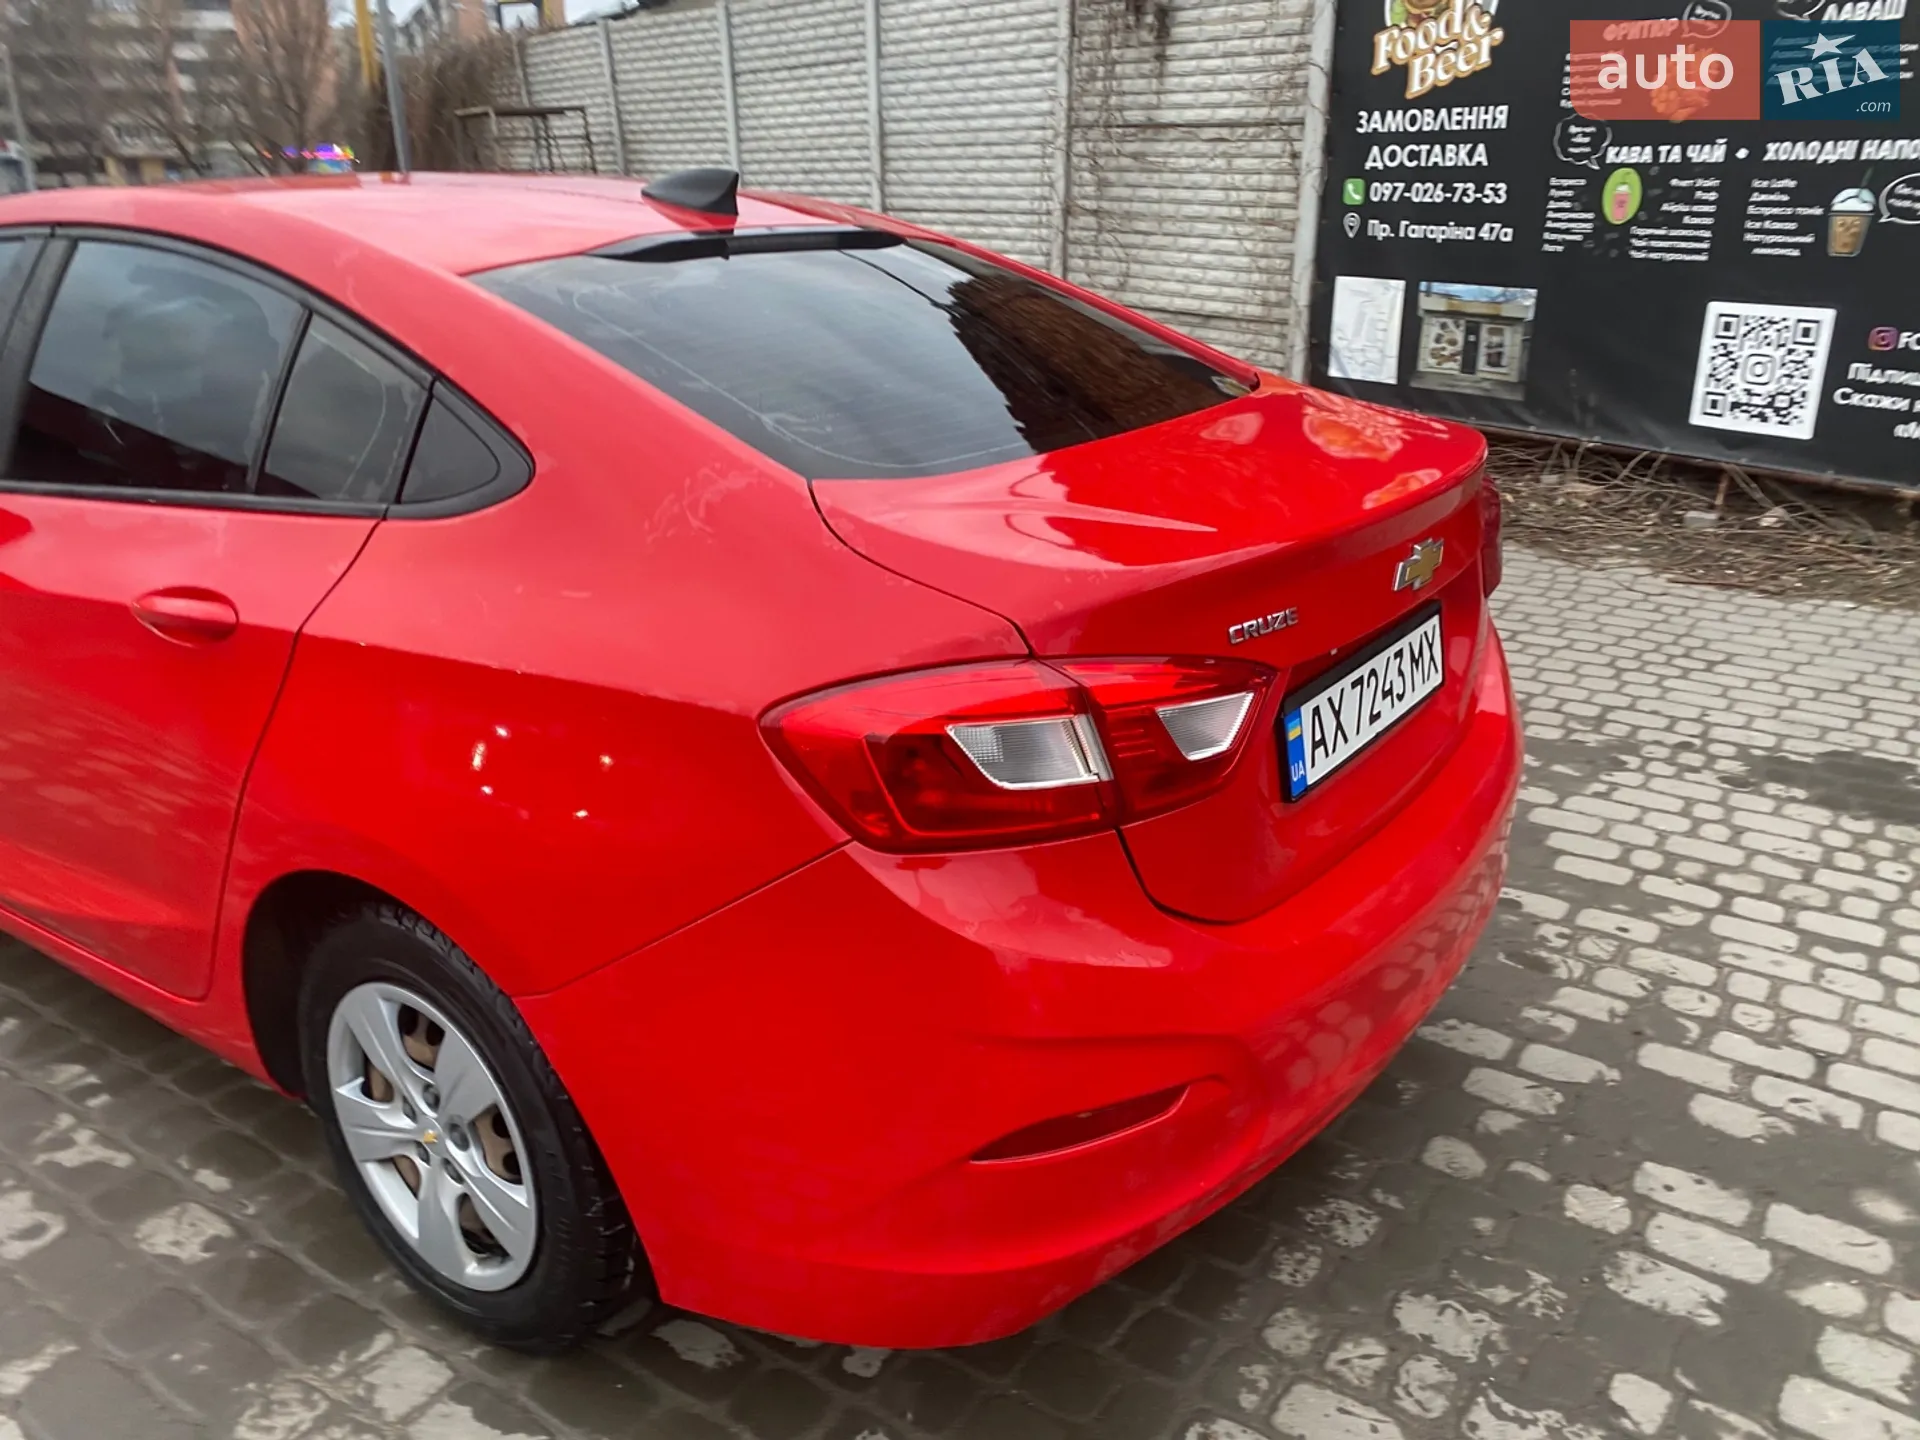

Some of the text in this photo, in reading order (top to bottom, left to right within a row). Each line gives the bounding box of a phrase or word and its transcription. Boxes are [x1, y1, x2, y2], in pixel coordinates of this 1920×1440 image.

[1405, 27, 1504, 99] Beer
[1355, 105, 1509, 133] ЗАМОВЛЕННЯ
[1364, 143, 1489, 171] ДОСТАВКА
[1605, 138, 1728, 164] КАВА ТА ЧАЙ
[1762, 139, 1860, 164] ХОЛОДНІ
[1369, 182, 1508, 204] 097-026-73-53
[1367, 219, 1514, 243] Пр. Гагаріна 47а
[1228, 607, 1299, 644] CRUZE
[1291, 760, 1306, 782] UA
